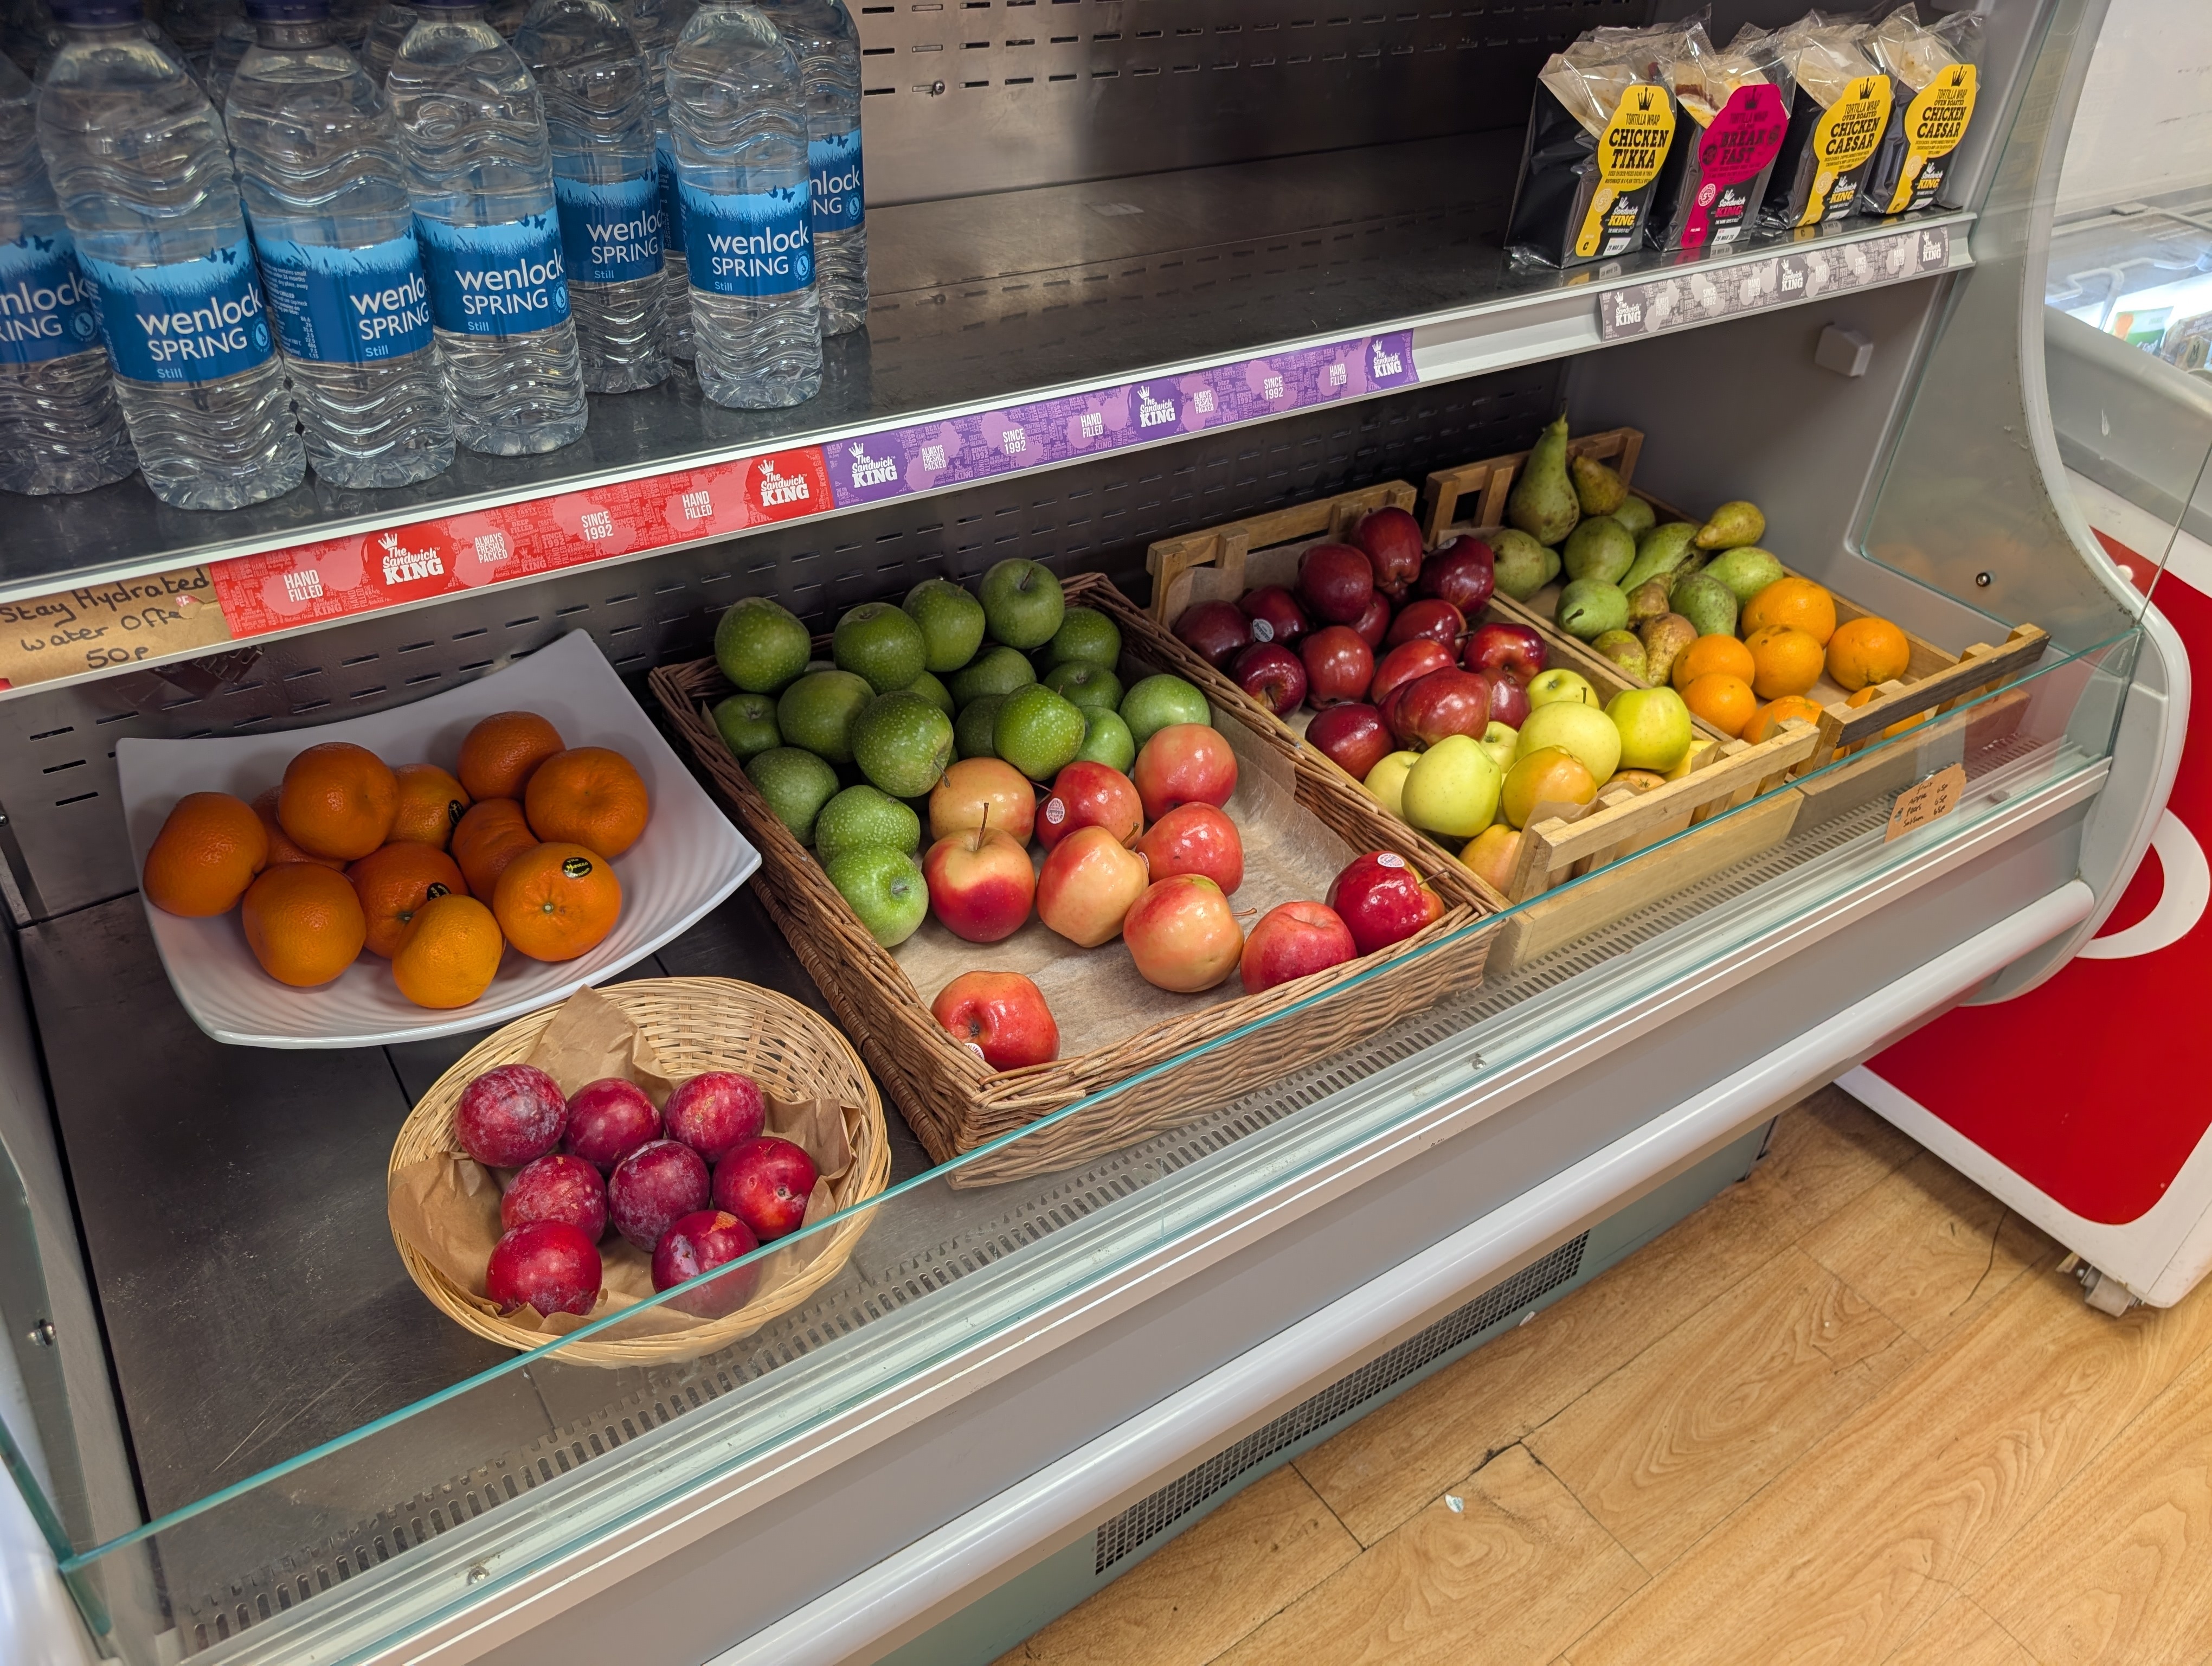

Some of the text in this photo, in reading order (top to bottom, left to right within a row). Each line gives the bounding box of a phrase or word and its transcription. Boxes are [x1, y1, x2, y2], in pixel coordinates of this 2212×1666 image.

[1937, 89, 1957, 100] TORTILLA
[1844, 100, 1880, 114] TORTILLA WRAP
[1922, 107, 1967, 121] CHICKEN
[1626, 113, 1660, 125] TORTILLA WRAP
[1730, 112, 1753, 124] TORTILLA
[1856, 110, 1877, 119] ROASTED
[1830, 117, 1881, 138] CHICKEN
[1917, 122, 1961, 138] CAESAR
[1609, 128, 1669, 148] CHICKEN
[1720, 130, 1766, 148] BREAK
[1825, 133, 1875, 155] CAESAR
[1611, 149, 1656, 169] TIKKA
[1720, 148, 1756, 165] FAST
[810, 165, 861, 195] nlock
[1917, 178, 1940, 189] KING
[1718, 196, 1746, 207] Sandwich
[1829, 190, 1855, 204] KING
[1612, 206, 1638, 215] Sandwich
[1714, 206, 1743, 217] KING
[1607, 215, 1636, 226] KING
[708, 220, 809, 255] wenlock
[591, 236, 658, 265] SPRING
[1583, 242, 1589, 251] C
[1894, 248, 1905, 258] HAND
[1923, 248, 1941, 262] KING
[454, 248, 565, 291] wenlock
[712, 256, 789, 278] SPRING
[1855, 265, 1866, 274] 1992
[594, 270, 614, 280] Still
[715, 281, 733, 292] Still
[1748, 278, 1760, 290] HAND
[1781, 278, 1803, 292] KING
[0, 271, 89, 316] nlock
[350, 272, 427, 316] wenlo
[1702, 287, 1716, 298] SINCE
[462, 289, 548, 316] SPRING
[1703, 297, 1716, 307] 1992
[136, 283, 262, 336] wenlock
[358, 302, 429, 341] SPRING
[1615, 311, 1641, 327] KING
[0, 315, 63, 342] ING
[468, 321, 490, 332] Still
[147, 327, 247, 361] SPRING
[365, 344, 389, 357] Still
[1373, 354, 1398, 366] Sandwich
[157, 368, 183, 379] Still
[1329, 364, 1346, 377] HAND
[1373, 361, 1402, 378] KING
[1264, 376, 1283, 389] SINCE
[1330, 374, 1347, 387] FILLED
[1194, 390, 1211, 400] ALWAYS
[1265, 387, 1283, 400] 1992
[1140, 399, 1173, 414] Sandwich
[1143, 397, 1155, 406] The
[1194, 398, 1212, 407] FRESHLY
[1195, 403, 1214, 414] PACKED
[1080, 413, 1102, 428] HAND
[1140, 408, 1175, 428] KING
[1003, 428, 1025, 443] SINCE
[1082, 425, 1103, 438] FILLED
[922, 445, 943, 457] ALWAYS
[1004, 440, 1026, 454] 1992
[852, 456, 893, 473] Sandwich
[856, 456, 871, 464] The
[923, 452, 944, 464] FRESHLY
[924, 460, 946, 471] PACKED
[761, 474, 805, 492] Sandwich
[766, 472, 781, 482] The
[852, 465, 898, 488] KING
[682, 491, 710, 509] HAND
[761, 484, 809, 507] KING
[685, 504, 712, 520] FILLED
[581, 511, 611, 528] SINCE
[584, 524, 614, 541] 1992
[475, 533, 503, 547] ALWAYS
[476, 540, 505, 554] FRESHLY
[382, 548, 438, 568] Sandwich
[388, 547, 407, 558] The
[479, 549, 508, 563] PACKED
[383, 558, 445, 585] KING
[284, 569, 320, 590] HAND
[0, 567, 210, 627] Stay Hydrated
[288, 584, 323, 603] FILLED
[564, 862, 588, 873] Morocco
[570, 868, 590, 876] Premium
